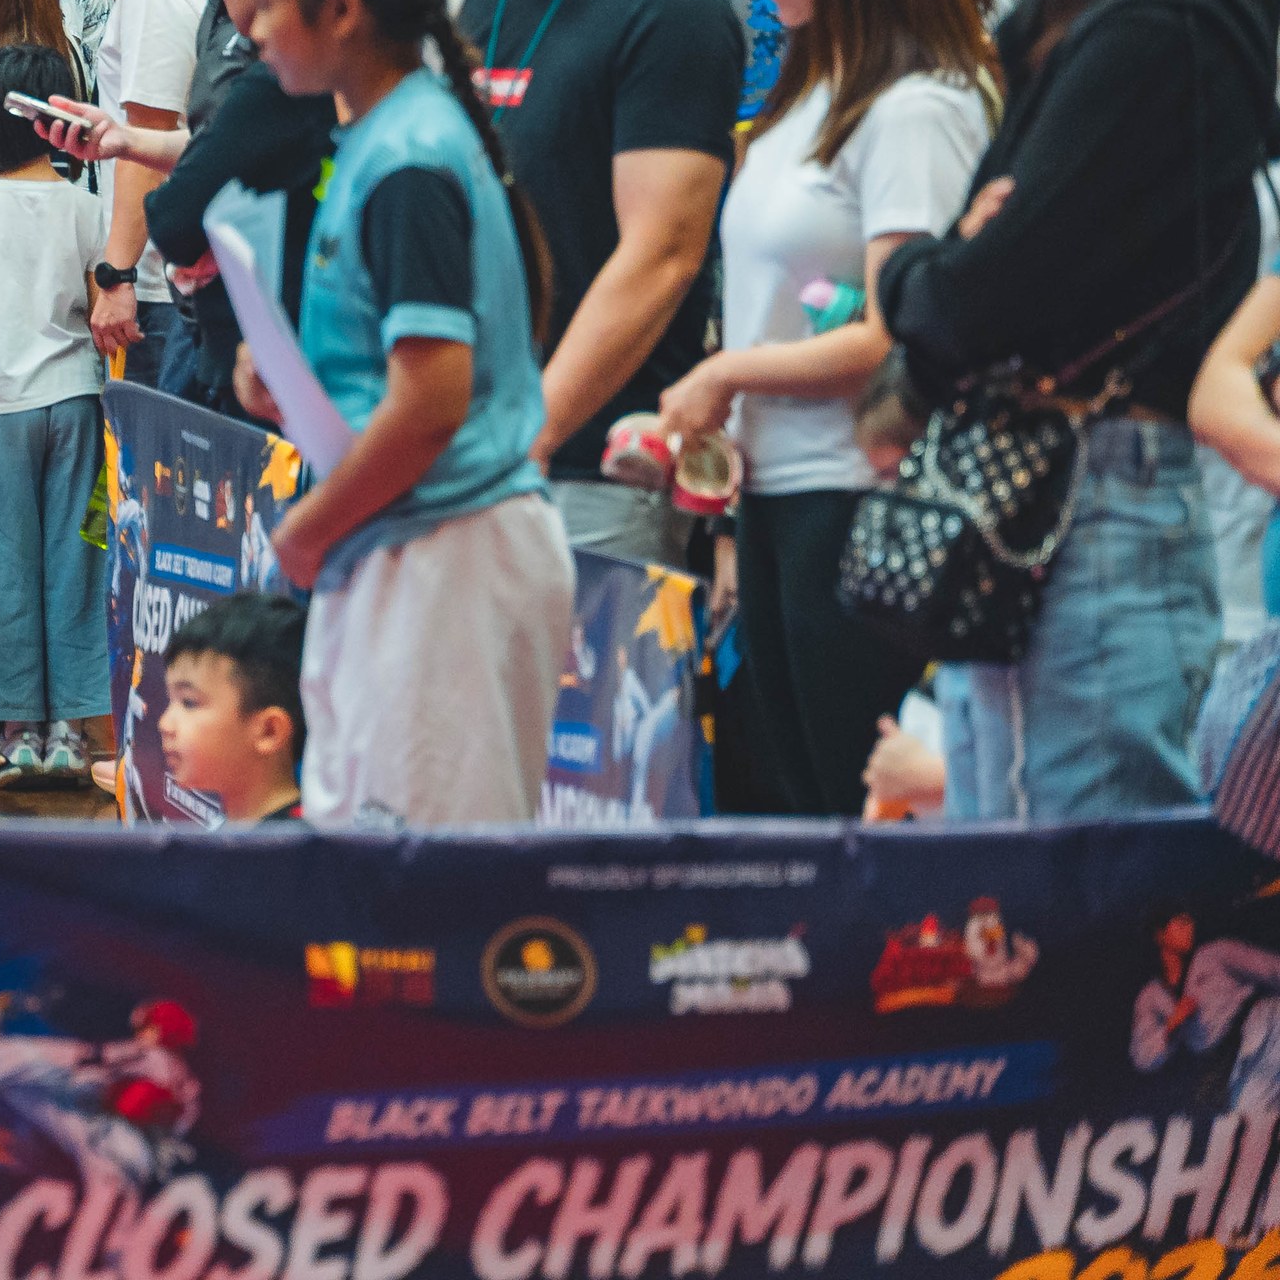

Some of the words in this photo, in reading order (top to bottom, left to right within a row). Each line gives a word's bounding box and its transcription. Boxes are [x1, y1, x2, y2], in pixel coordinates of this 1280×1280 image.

[326, 1096, 458, 1143] BLACK
[465, 1089, 567, 1135] BELT
[576, 1073, 820, 1128] TAEKWONDO
[825, 1057, 1007, 1111] ACADEMY
[470, 1111, 1280, 1280] CHAMPIONSHI
